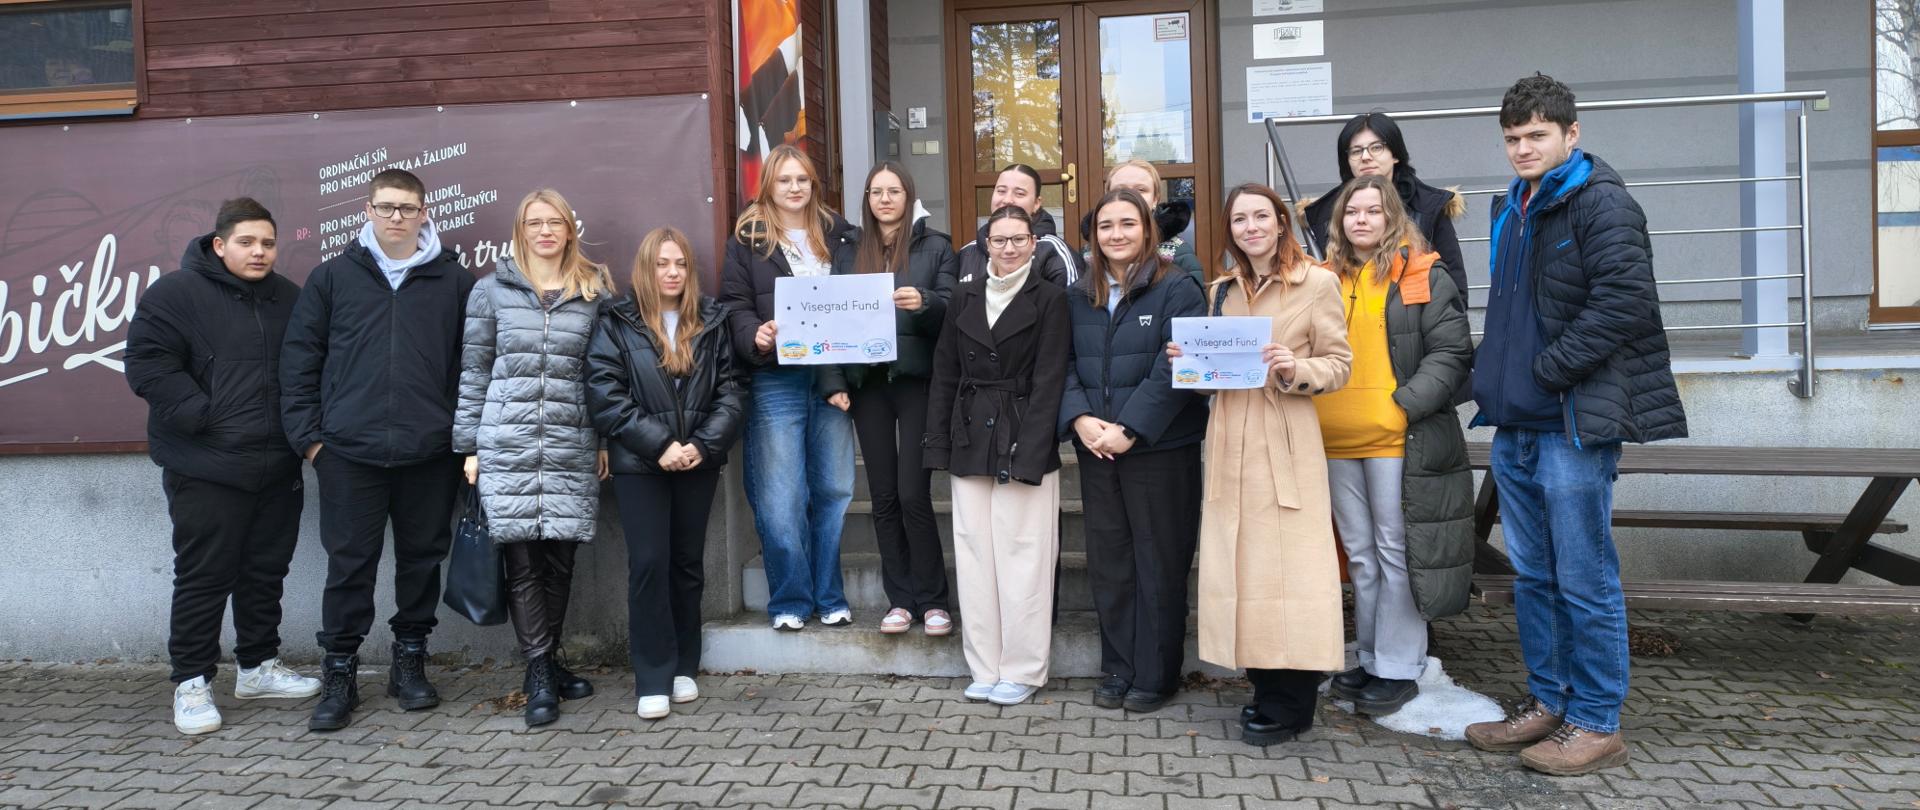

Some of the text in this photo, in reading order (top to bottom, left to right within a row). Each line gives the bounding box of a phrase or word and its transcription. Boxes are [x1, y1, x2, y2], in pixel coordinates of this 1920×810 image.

[319, 146, 388, 179] ORDINAČNÍ SÍŇ
[320, 180, 339, 196] PRO
[341, 169, 375, 190] NEMOCI
[414, 156, 422, 168] A
[423, 142, 467, 166] ŽALUDKU
[320, 183, 461, 235] PRO NEMO ALUDKU
[320, 239, 328, 251] A
[329, 232, 348, 248] PRO
[439, 202, 452, 217] PO
[454, 189, 498, 212] RŮZNÝCH
[296, 227, 311, 241] RP:
[800, 299, 880, 314] Visegrad Fund
[1194, 337, 1258, 349] Visegrad Fund
